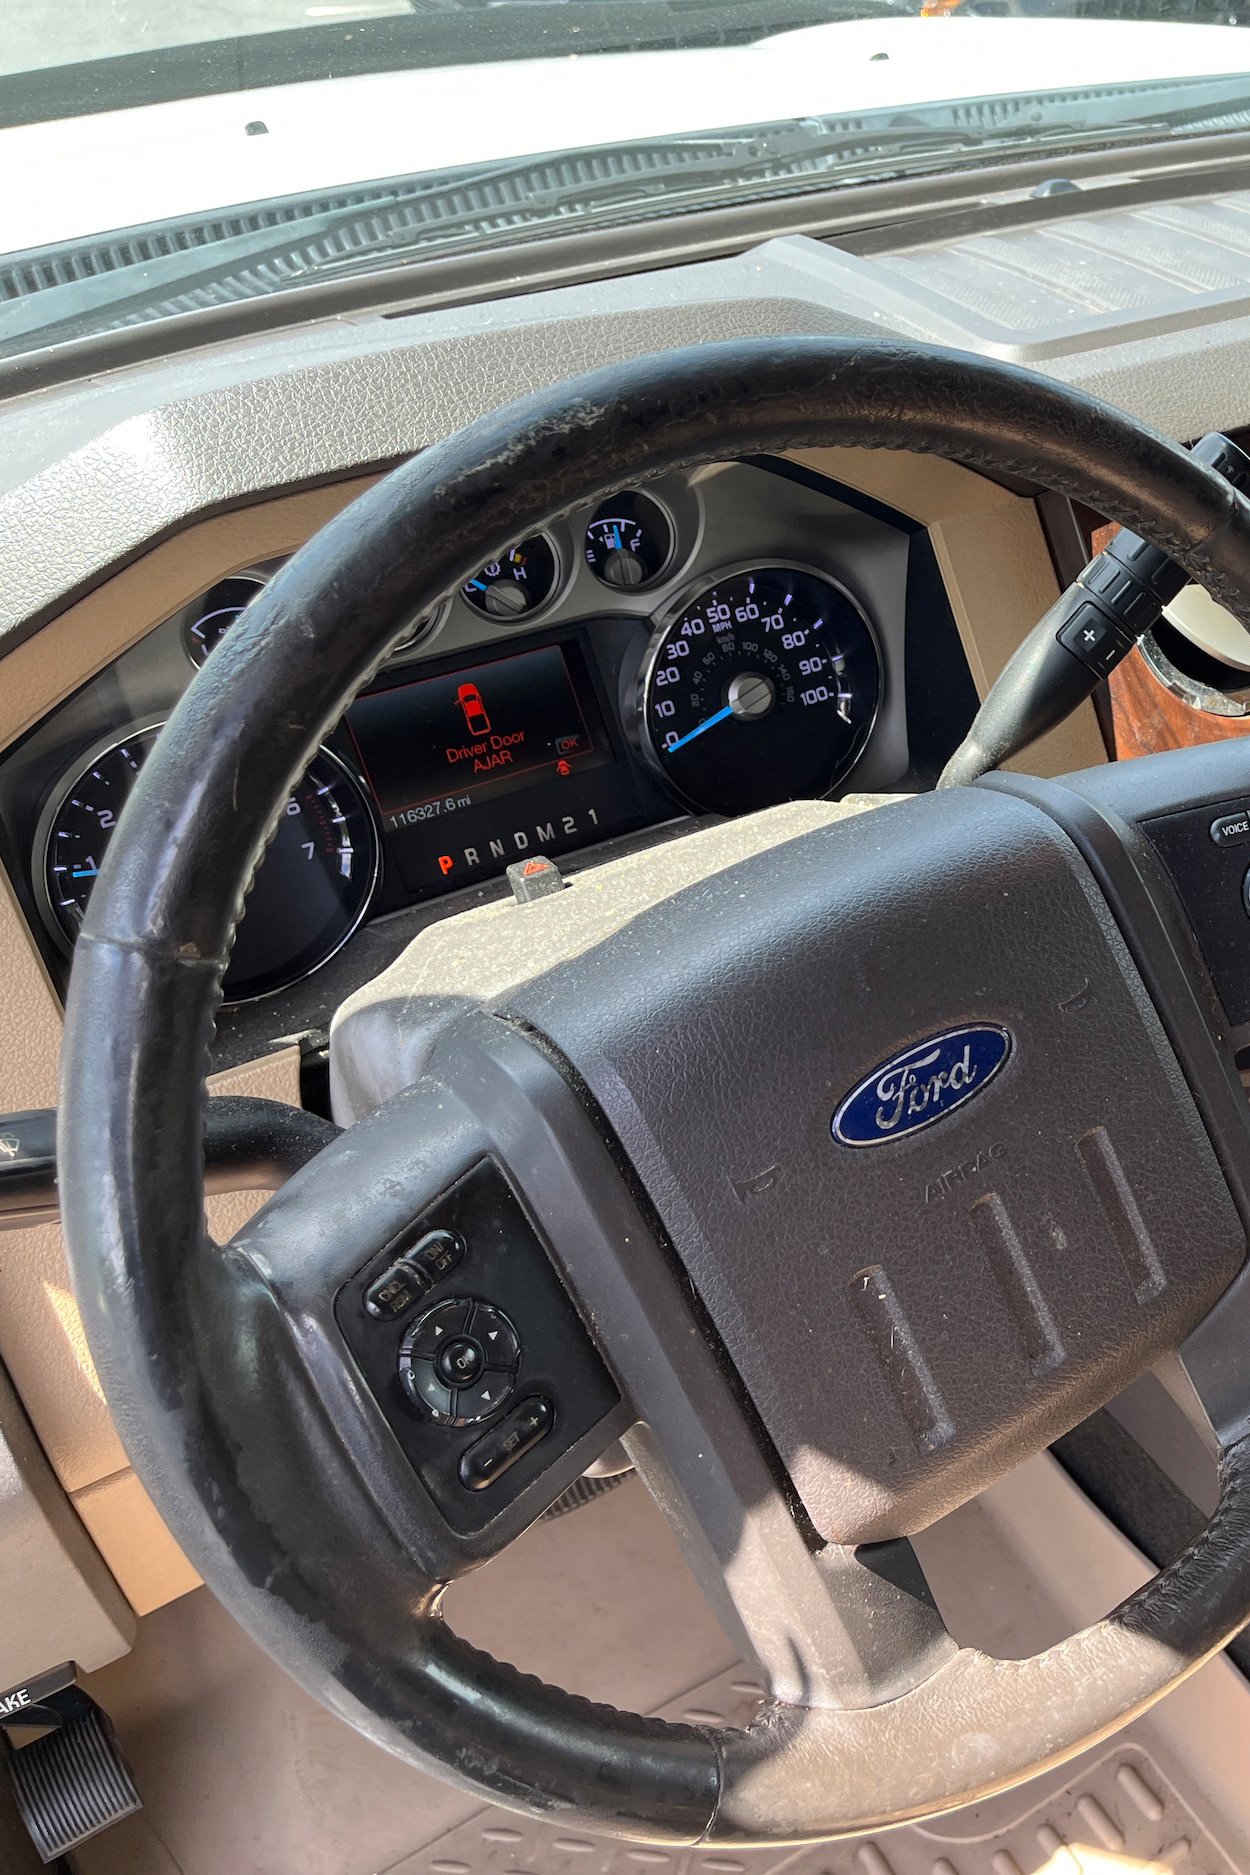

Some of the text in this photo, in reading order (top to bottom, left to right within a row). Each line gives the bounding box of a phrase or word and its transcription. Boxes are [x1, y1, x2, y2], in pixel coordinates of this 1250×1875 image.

[630, 538, 641, 551] F
[513, 566, 527, 580] H
[706, 604, 730, 622] 50
[735, 604, 760, 622] 60
[680, 618, 705, 636] 40
[712, 620, 732, 633] MPH
[761, 614, 784, 633] 70
[742, 641, 758, 652] 100
[781, 631, 806, 650] 80
[666, 641, 689, 660] 30
[763, 648, 778, 663] 120
[778, 664, 790, 680] 140
[798, 656, 822, 675] 90
[655, 667, 680, 686] 20
[692, 671, 702, 685] 40
[690, 693, 699, 707] 20
[800, 686, 828, 706] 100
[654, 700, 675, 717] 10
[446, 731, 526, 763] Driver Door
[561, 738, 579, 750] OK
[665, 731, 679, 747] 0
[473, 751, 513, 773] AJAR
[97, 809, 117, 829] 2
[390, 795, 472, 828] 116327.6 mi
[1222, 821, 1249, 836] VOICE
[301, 841, 315, 860] 7
[438, 809, 599, 875] P R N D M 2 1
[875, 1044, 978, 1130] Ford
[925, 1142, 1006, 1204] AIRBAG
[436, 1253, 452, 1270] OFF
[503, 1431, 520, 1450] SET
